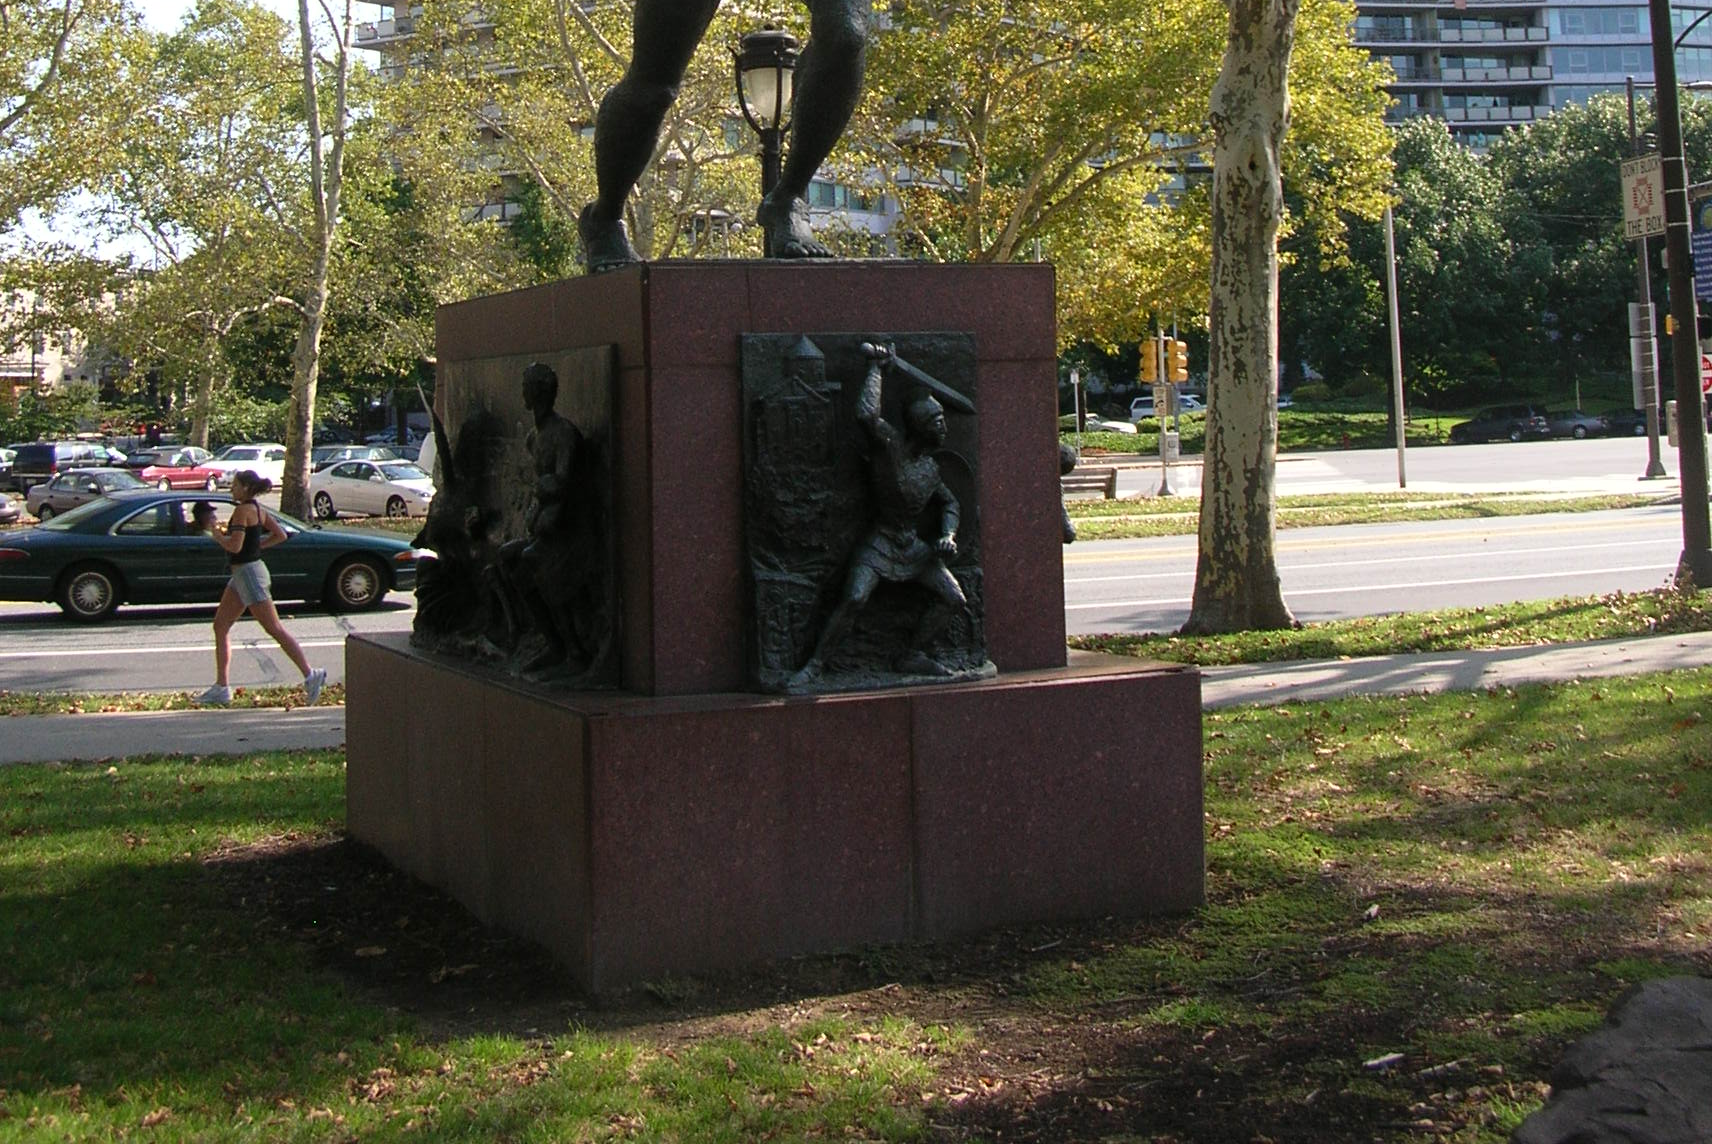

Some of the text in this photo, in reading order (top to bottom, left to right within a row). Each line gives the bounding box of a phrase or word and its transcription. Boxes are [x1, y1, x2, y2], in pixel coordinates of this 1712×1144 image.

[1640, 158, 1660, 174] BLOCK
[1628, 215, 1664, 235] THE BOX
